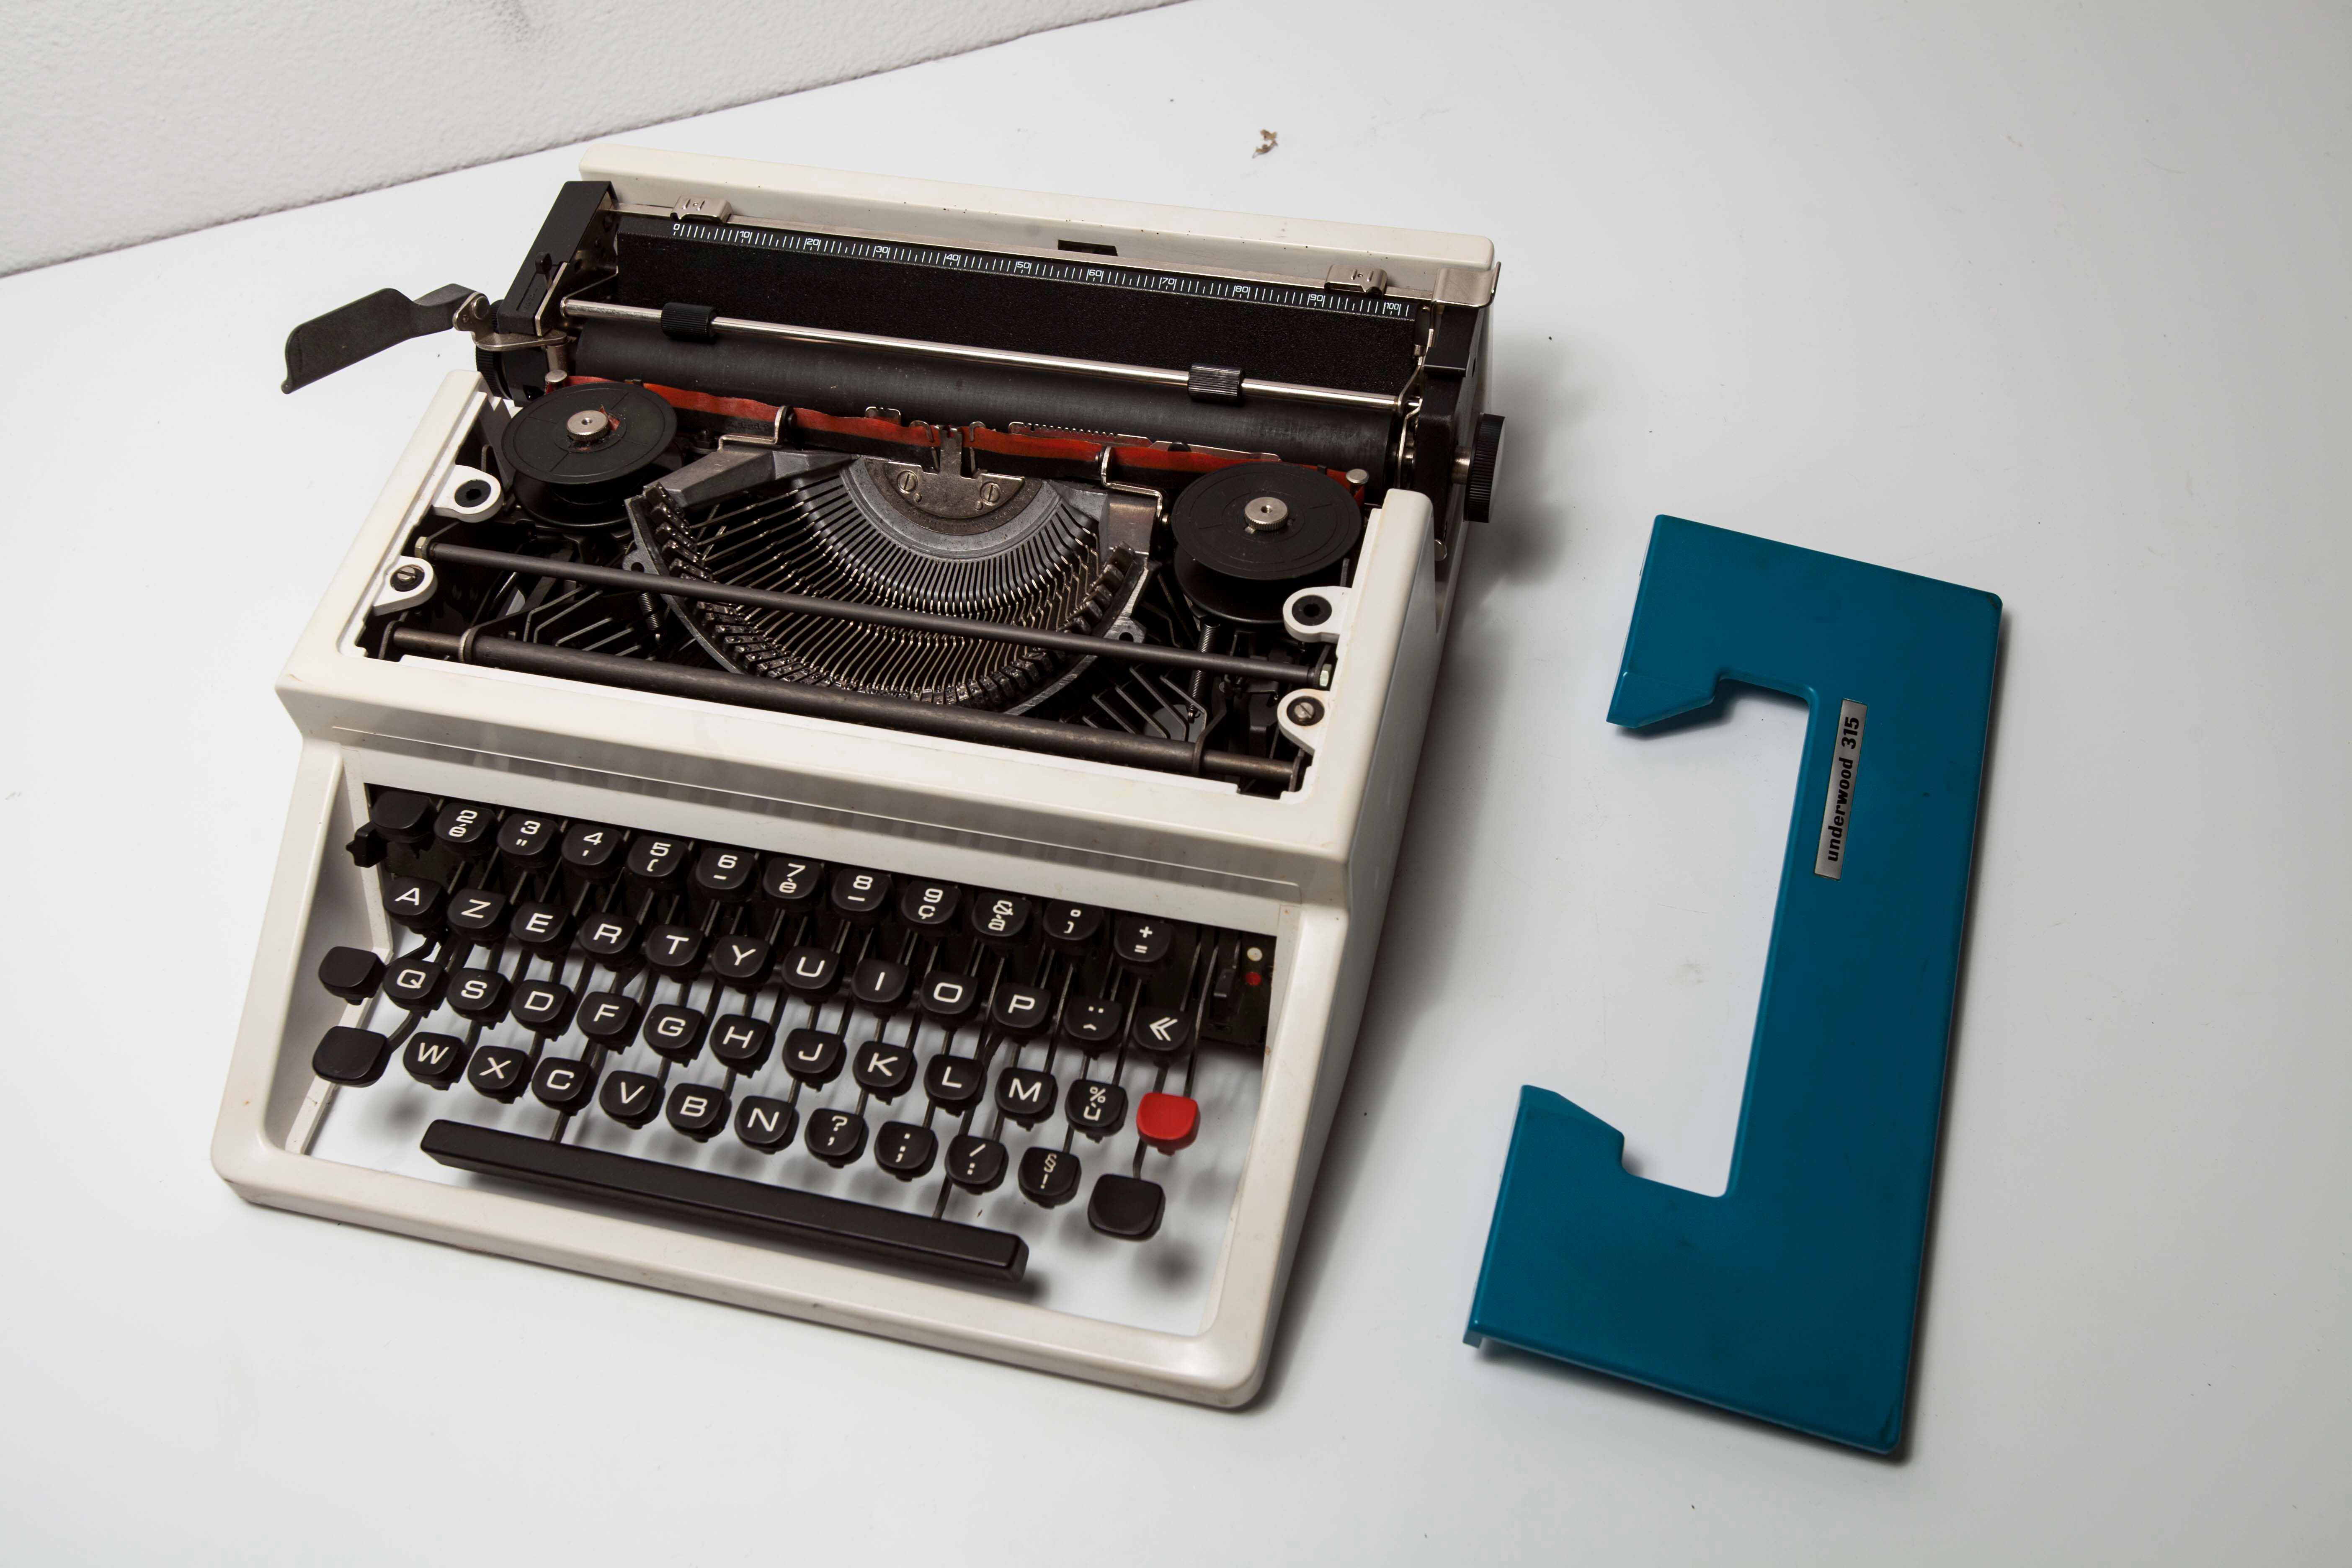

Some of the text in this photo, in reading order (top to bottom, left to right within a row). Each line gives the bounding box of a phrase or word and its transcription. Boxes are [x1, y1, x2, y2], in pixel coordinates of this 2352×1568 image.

[1828, 717, 1859, 861] underwood 315
[456, 810, 477, 823] 2
[449, 824, 466, 837] é
[521, 821, 540, 834] 3
[583, 833, 603, 845] 4
[650, 842, 671, 856] 5
[718, 855, 737, 868] 6
[787, 863, 805, 877] 7
[779, 878, 797, 893] è
[853, 875, 873, 890] 8
[395, 888, 419, 905] A
[923, 889, 943, 903] 9
[461, 899, 490, 918] Z
[918, 905, 935, 919] ç
[993, 900, 1013, 916] &
[526, 913, 553, 933] E
[988, 914, 1006, 931] à
[593, 923, 622, 944] R
[1140, 926, 1152, 938] +
[666, 935, 689, 954] T
[1135, 945, 1147, 953] =
[732, 945, 756, 965] Y
[797, 957, 825, 977] U
[397, 970, 426, 988] Q
[875, 972, 885, 990] I
[461, 980, 487, 999] S
[934, 983, 962, 1003] O
[524, 991, 554, 1011] D
[1008, 995, 1035, 1013] P
[594, 1004, 619, 1021] F
[658, 1017, 686, 1036] G
[723, 1026, 753, 1048] H
[418, 1043, 449, 1064] W
[798, 1044, 823, 1061] J
[480, 1057, 511, 1079] X
[868, 1053, 897, 1076] K
[547, 1070, 574, 1089] C
[942, 1067, 962, 1088] L
[621, 1082, 645, 1104] V
[1009, 1078, 1041, 1102] M
[1090, 1087, 1106, 1103] %
[680, 1096, 707, 1117] B
[1084, 1102, 1101, 1121] ù
[748, 1108, 779, 1132] N
[832, 1116, 847, 1131] ?
[970, 1144, 985, 1156] /
[1044, 1154, 1056, 1172] §
[1041, 1174, 1048, 1189] !
